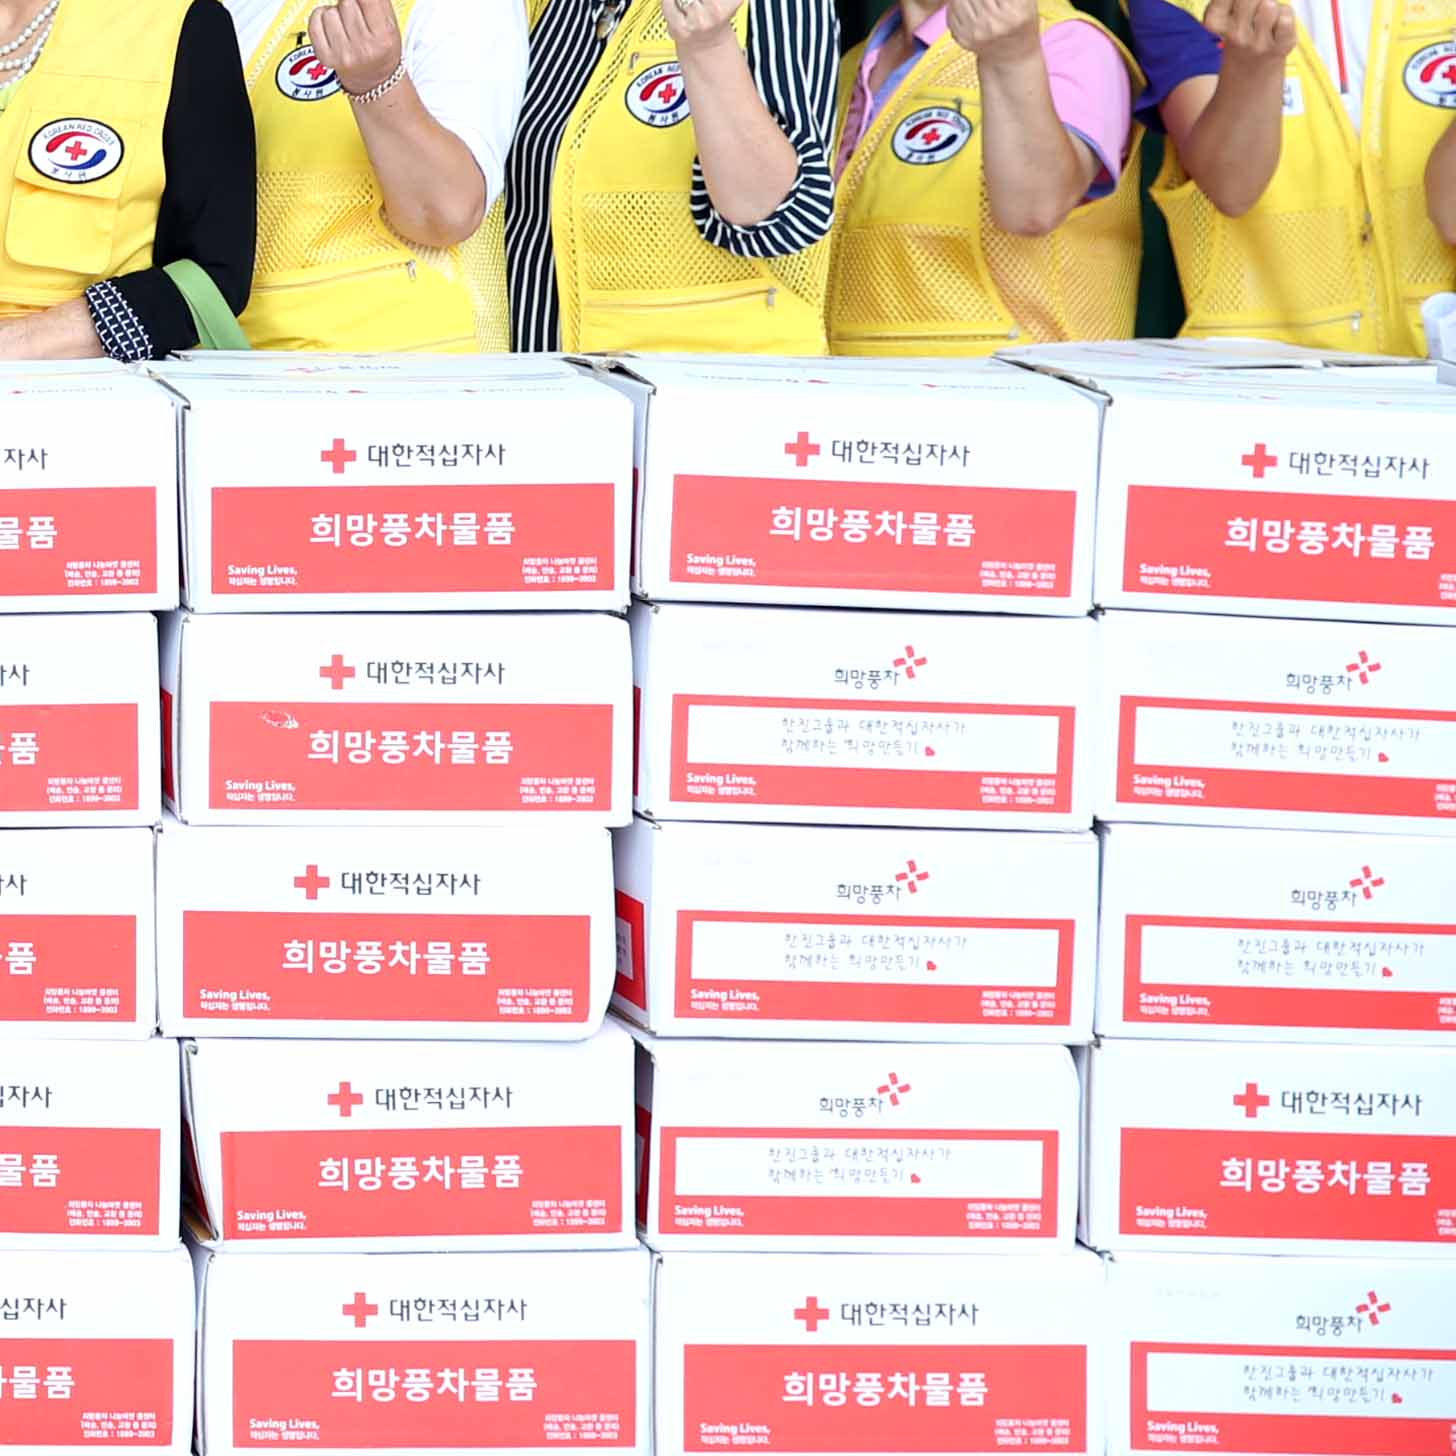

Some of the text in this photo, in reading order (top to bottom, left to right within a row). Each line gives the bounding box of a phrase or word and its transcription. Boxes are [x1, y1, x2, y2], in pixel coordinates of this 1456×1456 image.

[368, 443, 506, 467] 대한적십자사
[832, 440, 970, 467] 대한적십자사
[1289, 452, 1429, 480] 대한적십자사
[309, 512, 515, 547] 희망풍차물품
[769, 505, 976, 547] 희망풍차물품
[1225, 517, 1435, 560] 희망풍차물품
[367, 660, 505, 685] 대한적십자사
[834, 669, 901, 689] 희망풍차
[1286, 673, 1354, 693] 희망풍차
[308, 731, 514, 765] 희망풍차물품
[342, 871, 480, 896] 대한적십자사
[837, 884, 903, 904] 희망풍차
[1291, 890, 1358, 910] 희망풍차
[282, 939, 491, 975] 희망풍차물품
[376, 1087, 512, 1111] 대한적십자사
[819, 1097, 885, 1117] 희망풍차
[1281, 1090, 1422, 1116] 대한적십자사
[318, 1155, 523, 1191] 희망풍차물품
[1220, 1157, 1431, 1196] 희망풍차물품
[390, 1297, 527, 1321] 대한적십자사
[841, 1302, 979, 1326] 대한적십자사
[1295, 1315, 1365, 1336] 희망풍차
[331, 1367, 538, 1402] 희망풍차물품
[782, 1371, 988, 1407] 희망풍차물품
[248, 1418, 321, 1431] Saving Lives,
